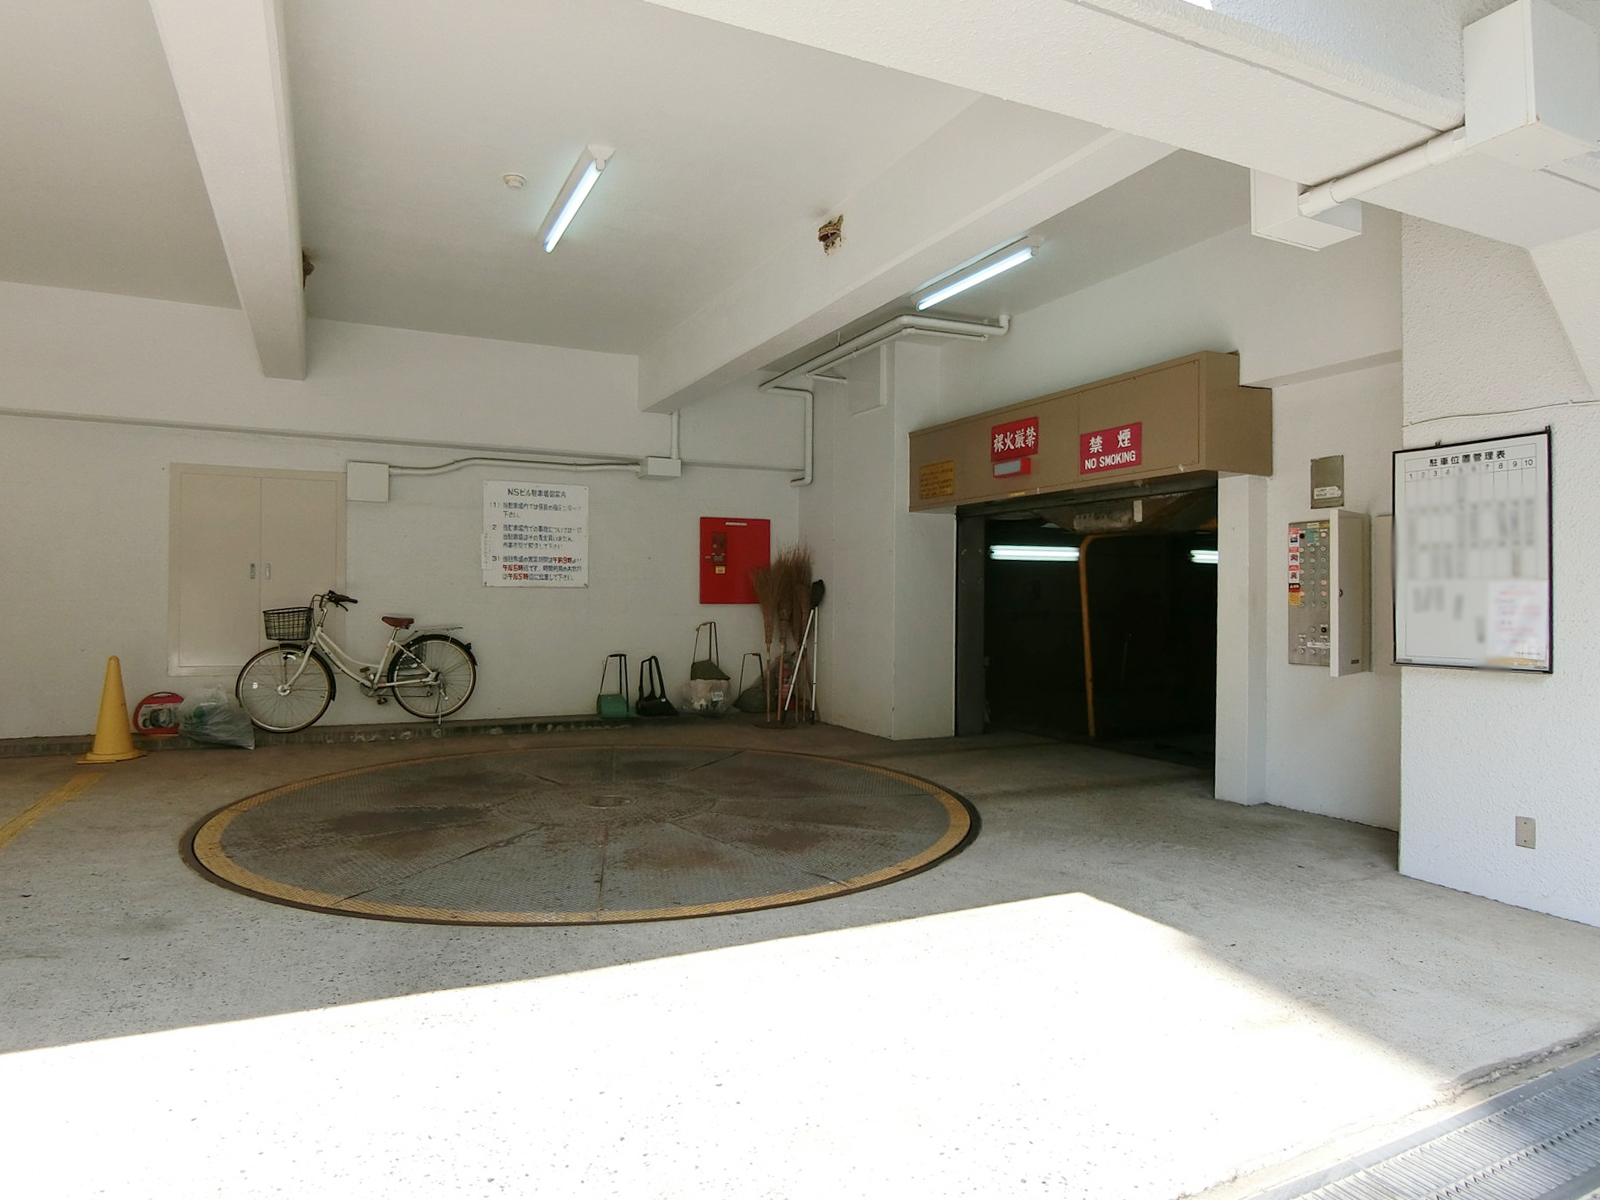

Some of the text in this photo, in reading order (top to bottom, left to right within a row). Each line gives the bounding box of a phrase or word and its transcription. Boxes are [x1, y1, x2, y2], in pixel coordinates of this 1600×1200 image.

[993, 426, 1037, 453] 裸火厳禁
[1084, 450, 1136, 470] NO SMOKING
[1429, 450, 1506, 467] 駐車位置管理表
